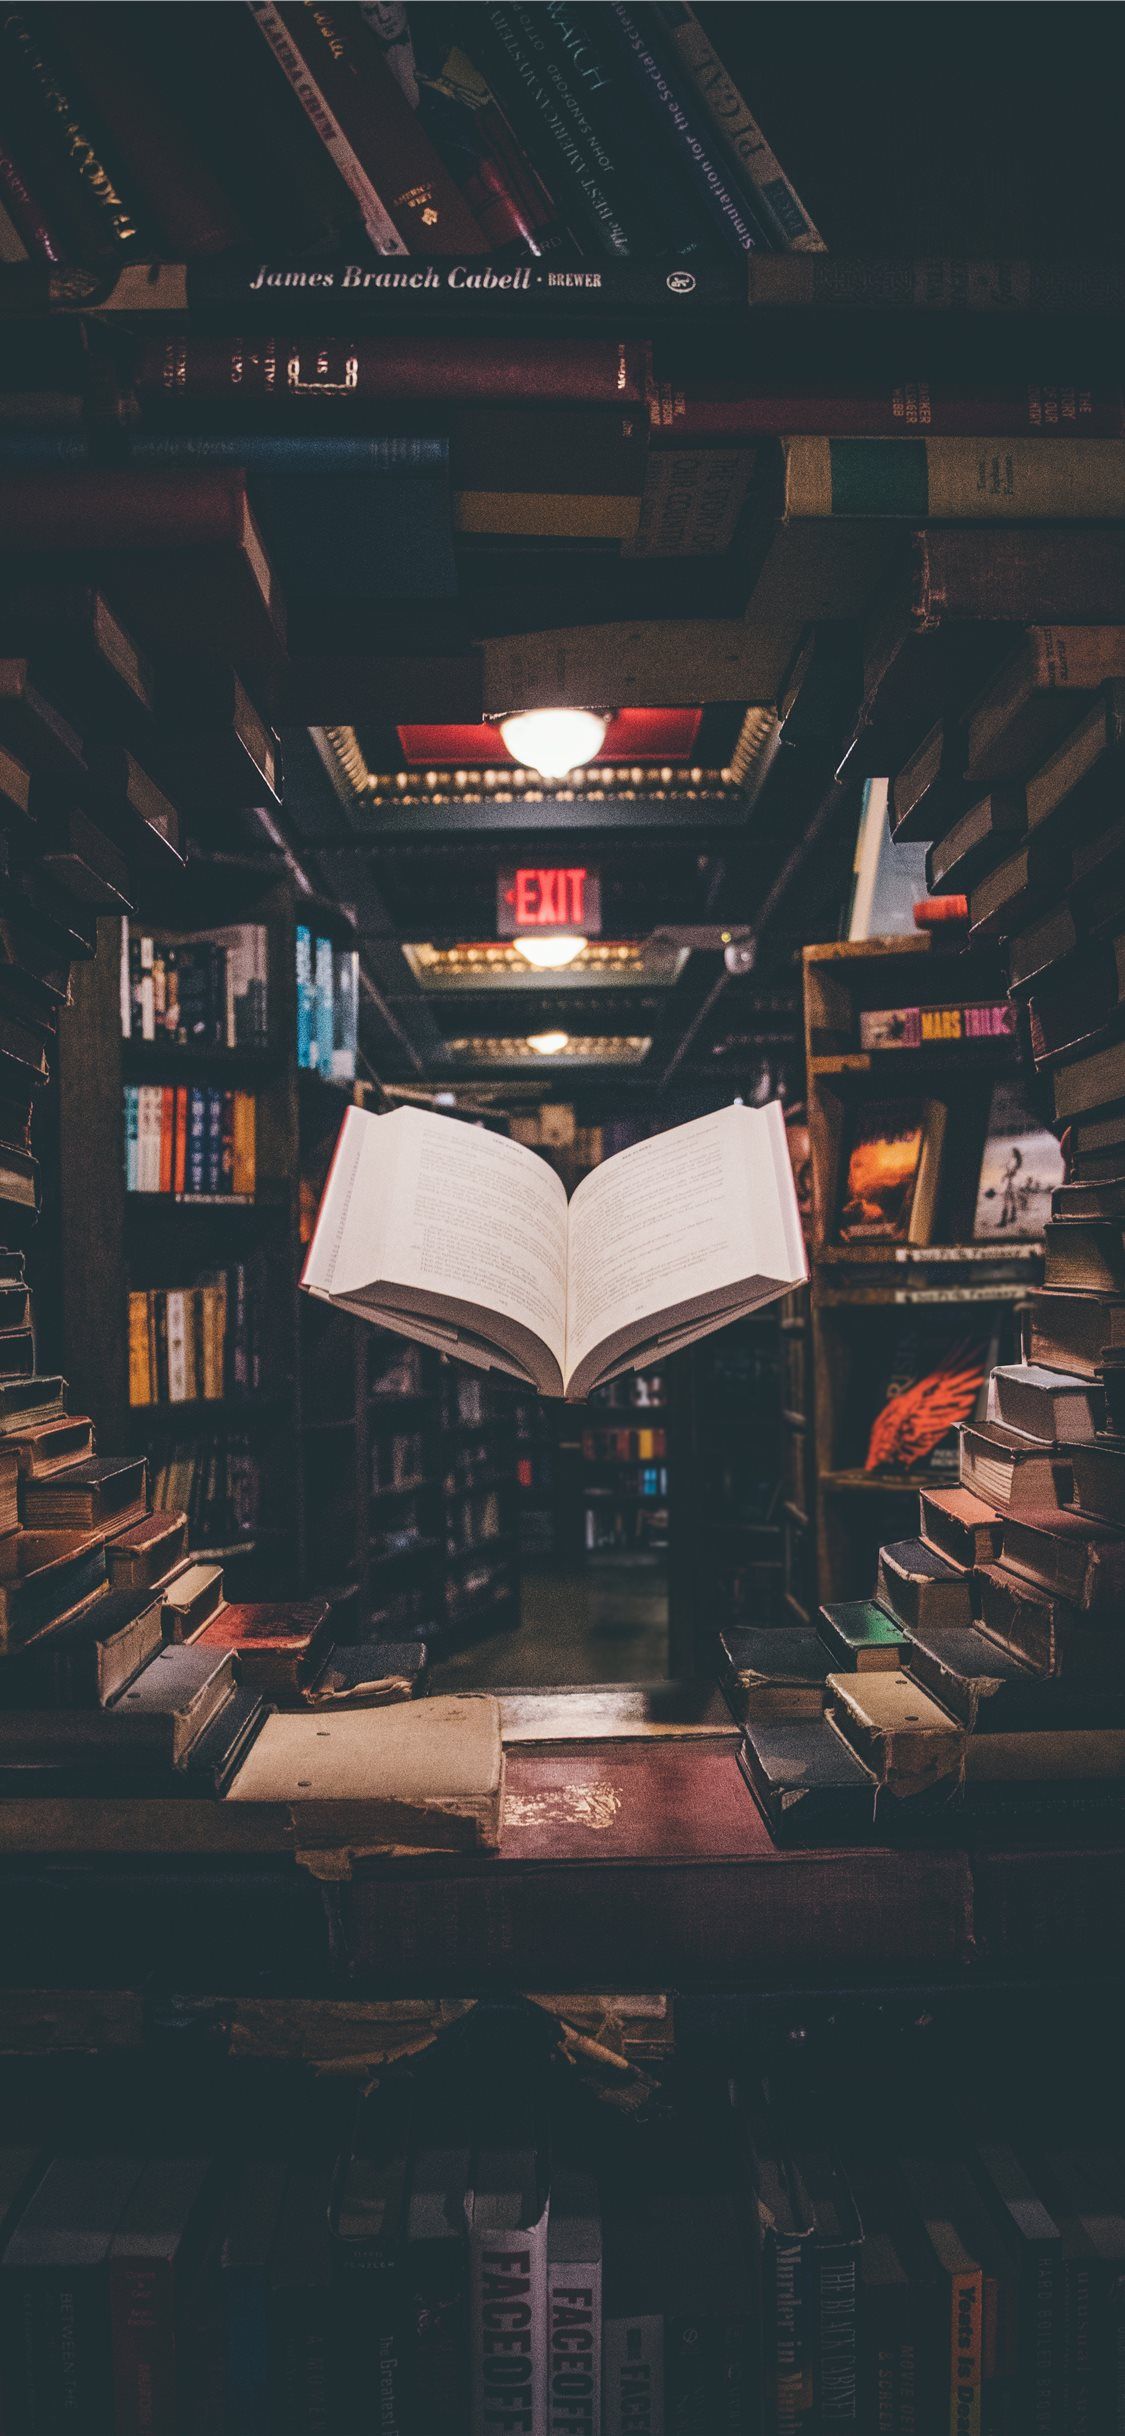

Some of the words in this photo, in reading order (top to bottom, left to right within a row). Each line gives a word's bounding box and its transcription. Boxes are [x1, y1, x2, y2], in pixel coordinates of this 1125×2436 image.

[545, 61, 592, 135] SANDFORD
[636, 48, 674, 102] Social
[531, 85, 590, 177] AMERICAN
[665, 100, 690, 132] the
[586, 134, 614, 174] JOHN
[684, 131, 707, 162] for
[580, 174, 614, 221] BEST
[698, 159, 756, 250] Simulation
[250, 266, 334, 290] James
[340, 266, 441, 289] Branch
[447, 266, 532, 290] Cabell
[548, 273, 602, 288] BREWER
[1044, 401, 1058, 424] OUR
[1061, 386, 1076, 420] STORY
[1078, 391, 1092, 414] THE
[515, 869, 586, 925] EXIT
[921, 1010, 961, 1040] MARS
[775, 2244, 802, 2333] Murder
[819, 2260, 855, 2294] THE
[1037, 2257, 1052, 2300] HARD
[482, 2250, 532, 2432] FACEOFF
[819, 2298, 856, 2350] BLACK
[958, 2286, 975, 2349] Yeats
[1037, 2309, 1052, 2369] BOILED
[1076, 2271, 1092, 2372] unusual
[379, 2335, 394, 2356] The
[552, 2287, 593, 2435] FACEOFF
[776, 2339, 802, 2364] in
[958, 2356, 974, 2378] Is
[379, 2358, 398, 2427] Greatest
[819, 2354, 856, 2421] CABINET
